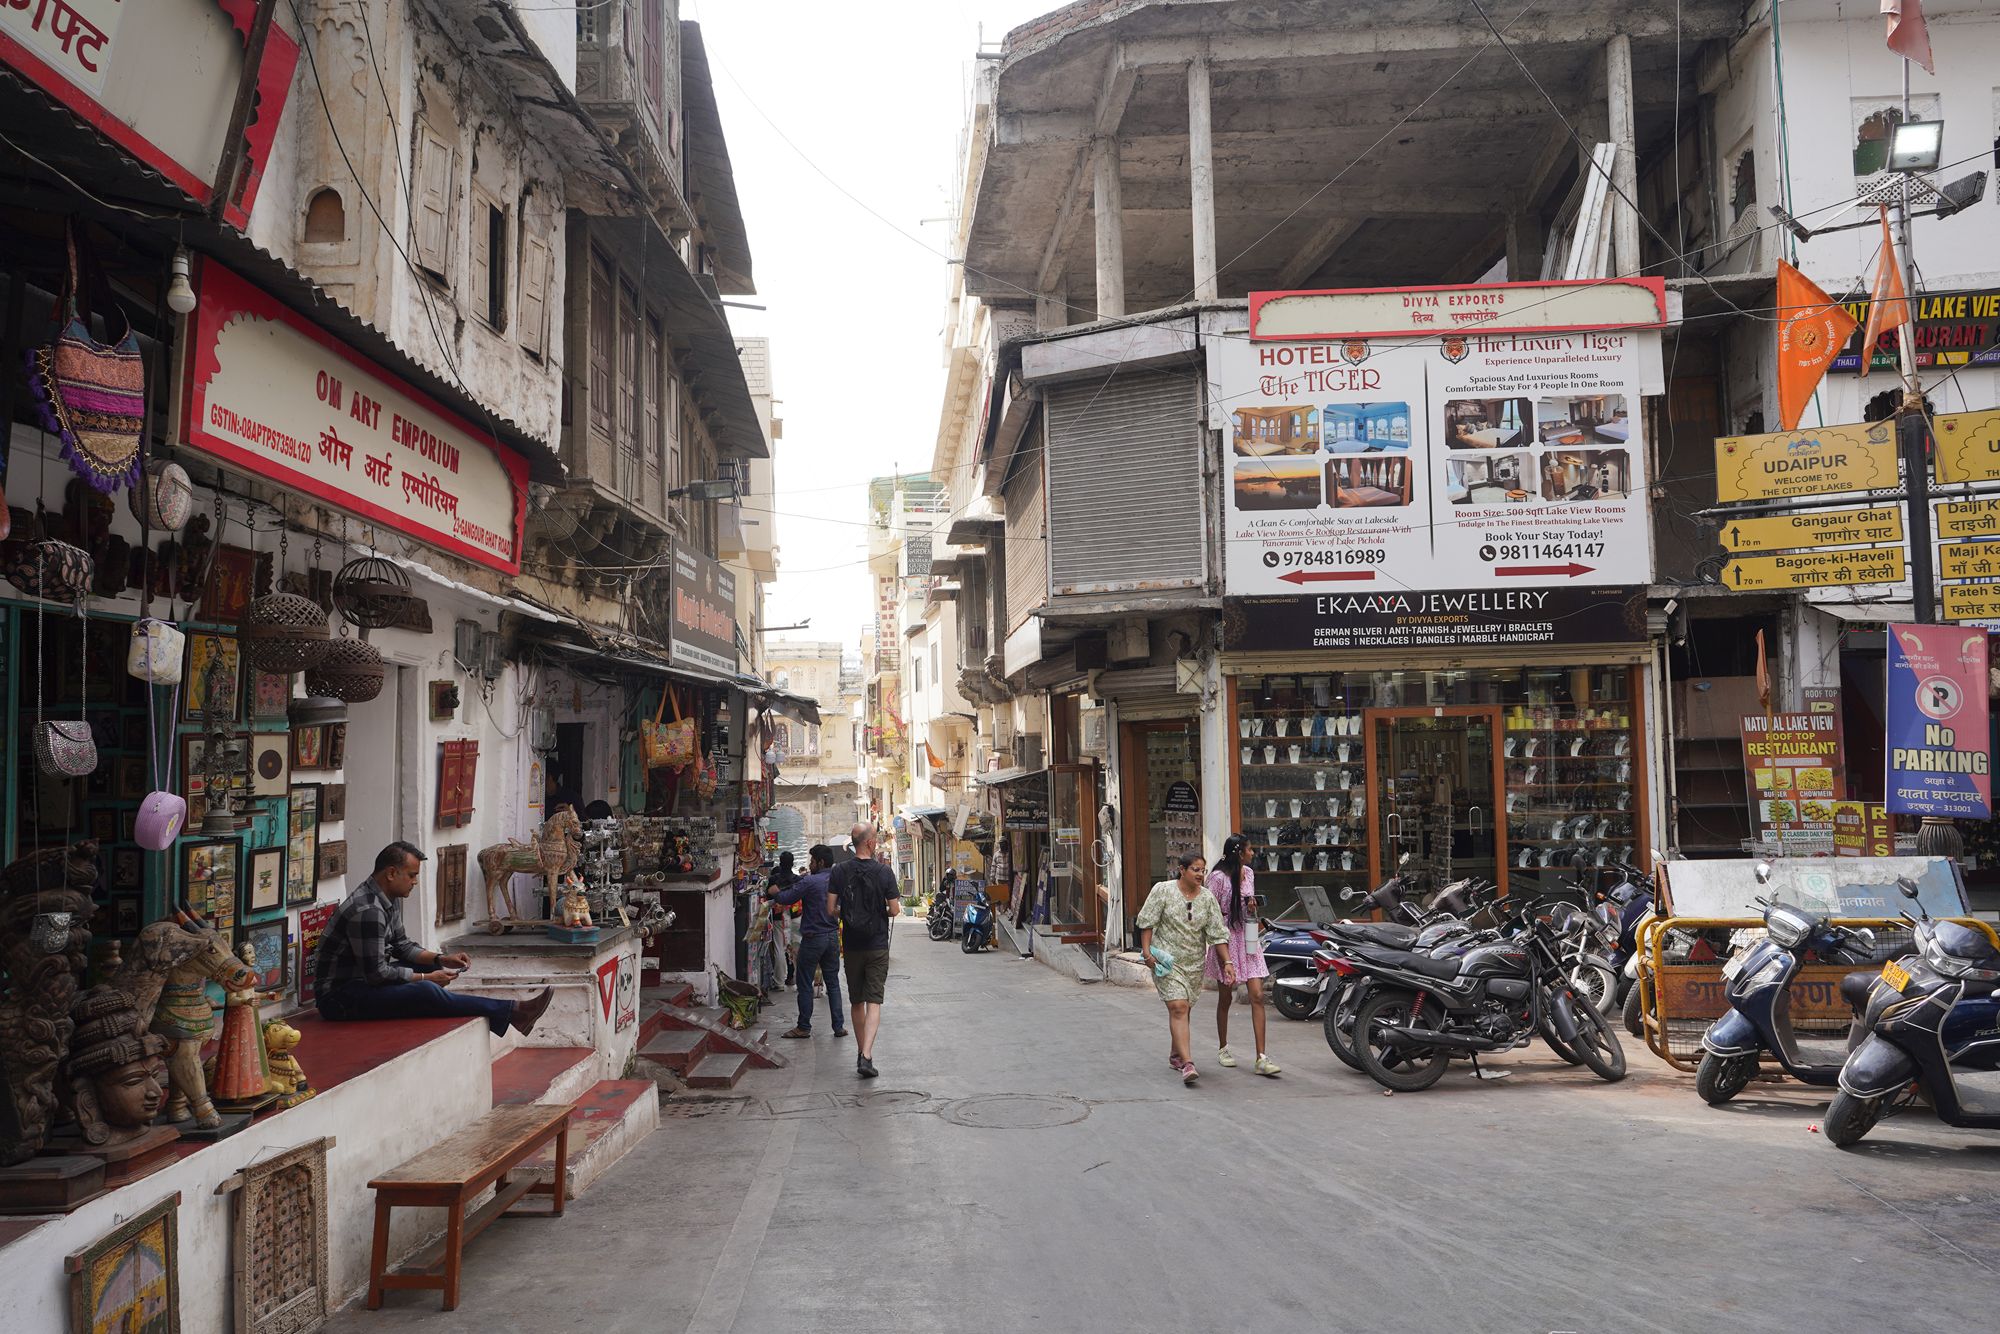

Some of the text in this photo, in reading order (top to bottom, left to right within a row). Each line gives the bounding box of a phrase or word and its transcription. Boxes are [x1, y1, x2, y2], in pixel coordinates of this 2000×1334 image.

[1403, 294, 1504, 307] DIVYA EXPORTS
[1920, 296, 1966, 319] LAKE
[1472, 333, 1627, 354] The Luxury Tiger
[1260, 346, 1340, 366] HOTEL
[1485, 354, 1622, 366] Experience Unparalleled Luxury
[1837, 358, 1856, 367] THALI
[1259, 368, 1381, 401] The TIGER
[1469, 371, 1598, 384] Spacious And Luxurious Rooms
[1445, 384, 1497, 393] Comfortable
[1498, 383, 1516, 393] Stay
[1517, 382, 1531, 391] For
[1540, 381, 1569, 391] People
[1571, 381, 1579, 389] In
[1580, 380, 1598, 388] One
[1599, 379, 1624, 388] Room
[316, 369, 460, 475] OM ART EMPORIUM
[318, 425, 354, 472] ओम
[364, 452, 393, 488] आर्ट
[1763, 454, 1848, 475] UDAIPUR
[1774, 474, 1822, 485] WELCOME
[1762, 482, 1853, 497] THE CITY OF LAKES
[1455, 506, 1626, 518] Room Size: 500 Sqft Lake View Rooms
[1947, 500, 1982, 515] Daiji
[1256, 519, 1277, 527] Clean
[1280, 519, 1287, 527] &
[1288, 517, 1335, 528] Comfortable
[1337, 517, 1354, 527] Stay
[1364, 515, 1399, 524] Lakeside
[1458, 521, 1486, 529] Indulge
[1535, 518, 1582, 527] Breathtaking
[1792, 510, 1893, 528] Gangaur Ghat
[1948, 516, 1997, 532] दाइजी
[1235, 530, 1255, 538] Lake
[1257, 529, 1276, 537] View
[1278, 529, 1304, 537] Rooms
[1315, 527, 1346, 537] Rooftop
[1347, 526, 1391, 535] Restaurant
[1392, 525, 1412, 534] With
[1485, 529, 1604, 541] Book Your Stay Today!
[1812, 526, 1894, 543] गणगौर घाट
[1262, 536, 1385, 547] Panoramic View of Lake Pichola
[1283, 549, 1386, 566] 9784816989
[1500, 543, 1605, 560] 9811464147
[1949, 547, 1979, 559] Maji
[1776, 550, 1894, 569] Bagore-ki-Haveli
[1950, 558, 1992, 575] माँ जी
[1790, 564, 1894, 584] बागौर की हवेली
[1950, 586, 1987, 598] Fateh
[1317, 591, 1549, 614] EKAAYA JEWELLERY
[1951, 600, 1985, 616] फतेह
[1434, 615, 1469, 623] EXPORTS
[1314, 623, 1553, 637] GERMAN SILVER ANTI-TARNISH JEWELLERY BRACLETS
[1313, 632, 1554, 646] EARINGS NECKLACES BANGLES MARBLE HANDICRAFT
[1805, 689, 1837, 698] ROOF TOP
[1744, 715, 1834, 732] NATUAL LAKE VIEW
[1795, 732, 1816, 740] TOP
[1925, 724, 1954, 746] No
[1893, 748, 1988, 774] PARKING
[1943, 804, 1971, 813] 313001
[1786, 830, 1809, 838] CLASSES
